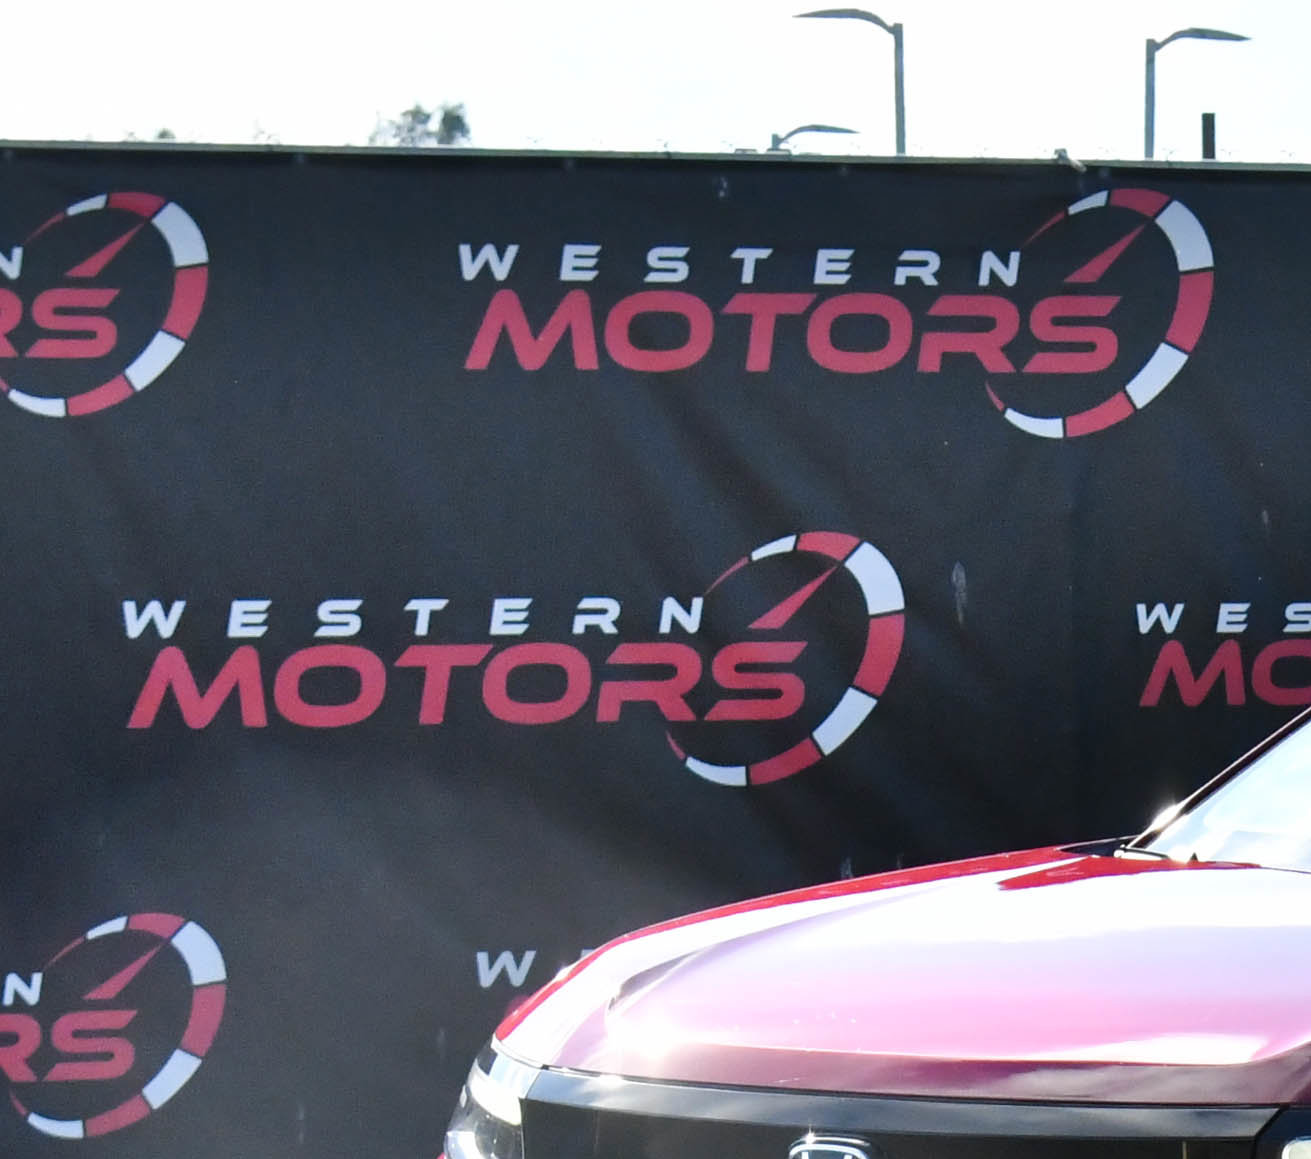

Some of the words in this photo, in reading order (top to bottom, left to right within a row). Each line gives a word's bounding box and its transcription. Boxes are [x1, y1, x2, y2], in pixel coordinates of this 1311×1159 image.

[459, 243, 1022, 287] WESTERN
[464, 289, 1122, 374] MOTORS
[122, 597, 704, 639] WESTERN
[126, 641, 809, 729] MOTORS
